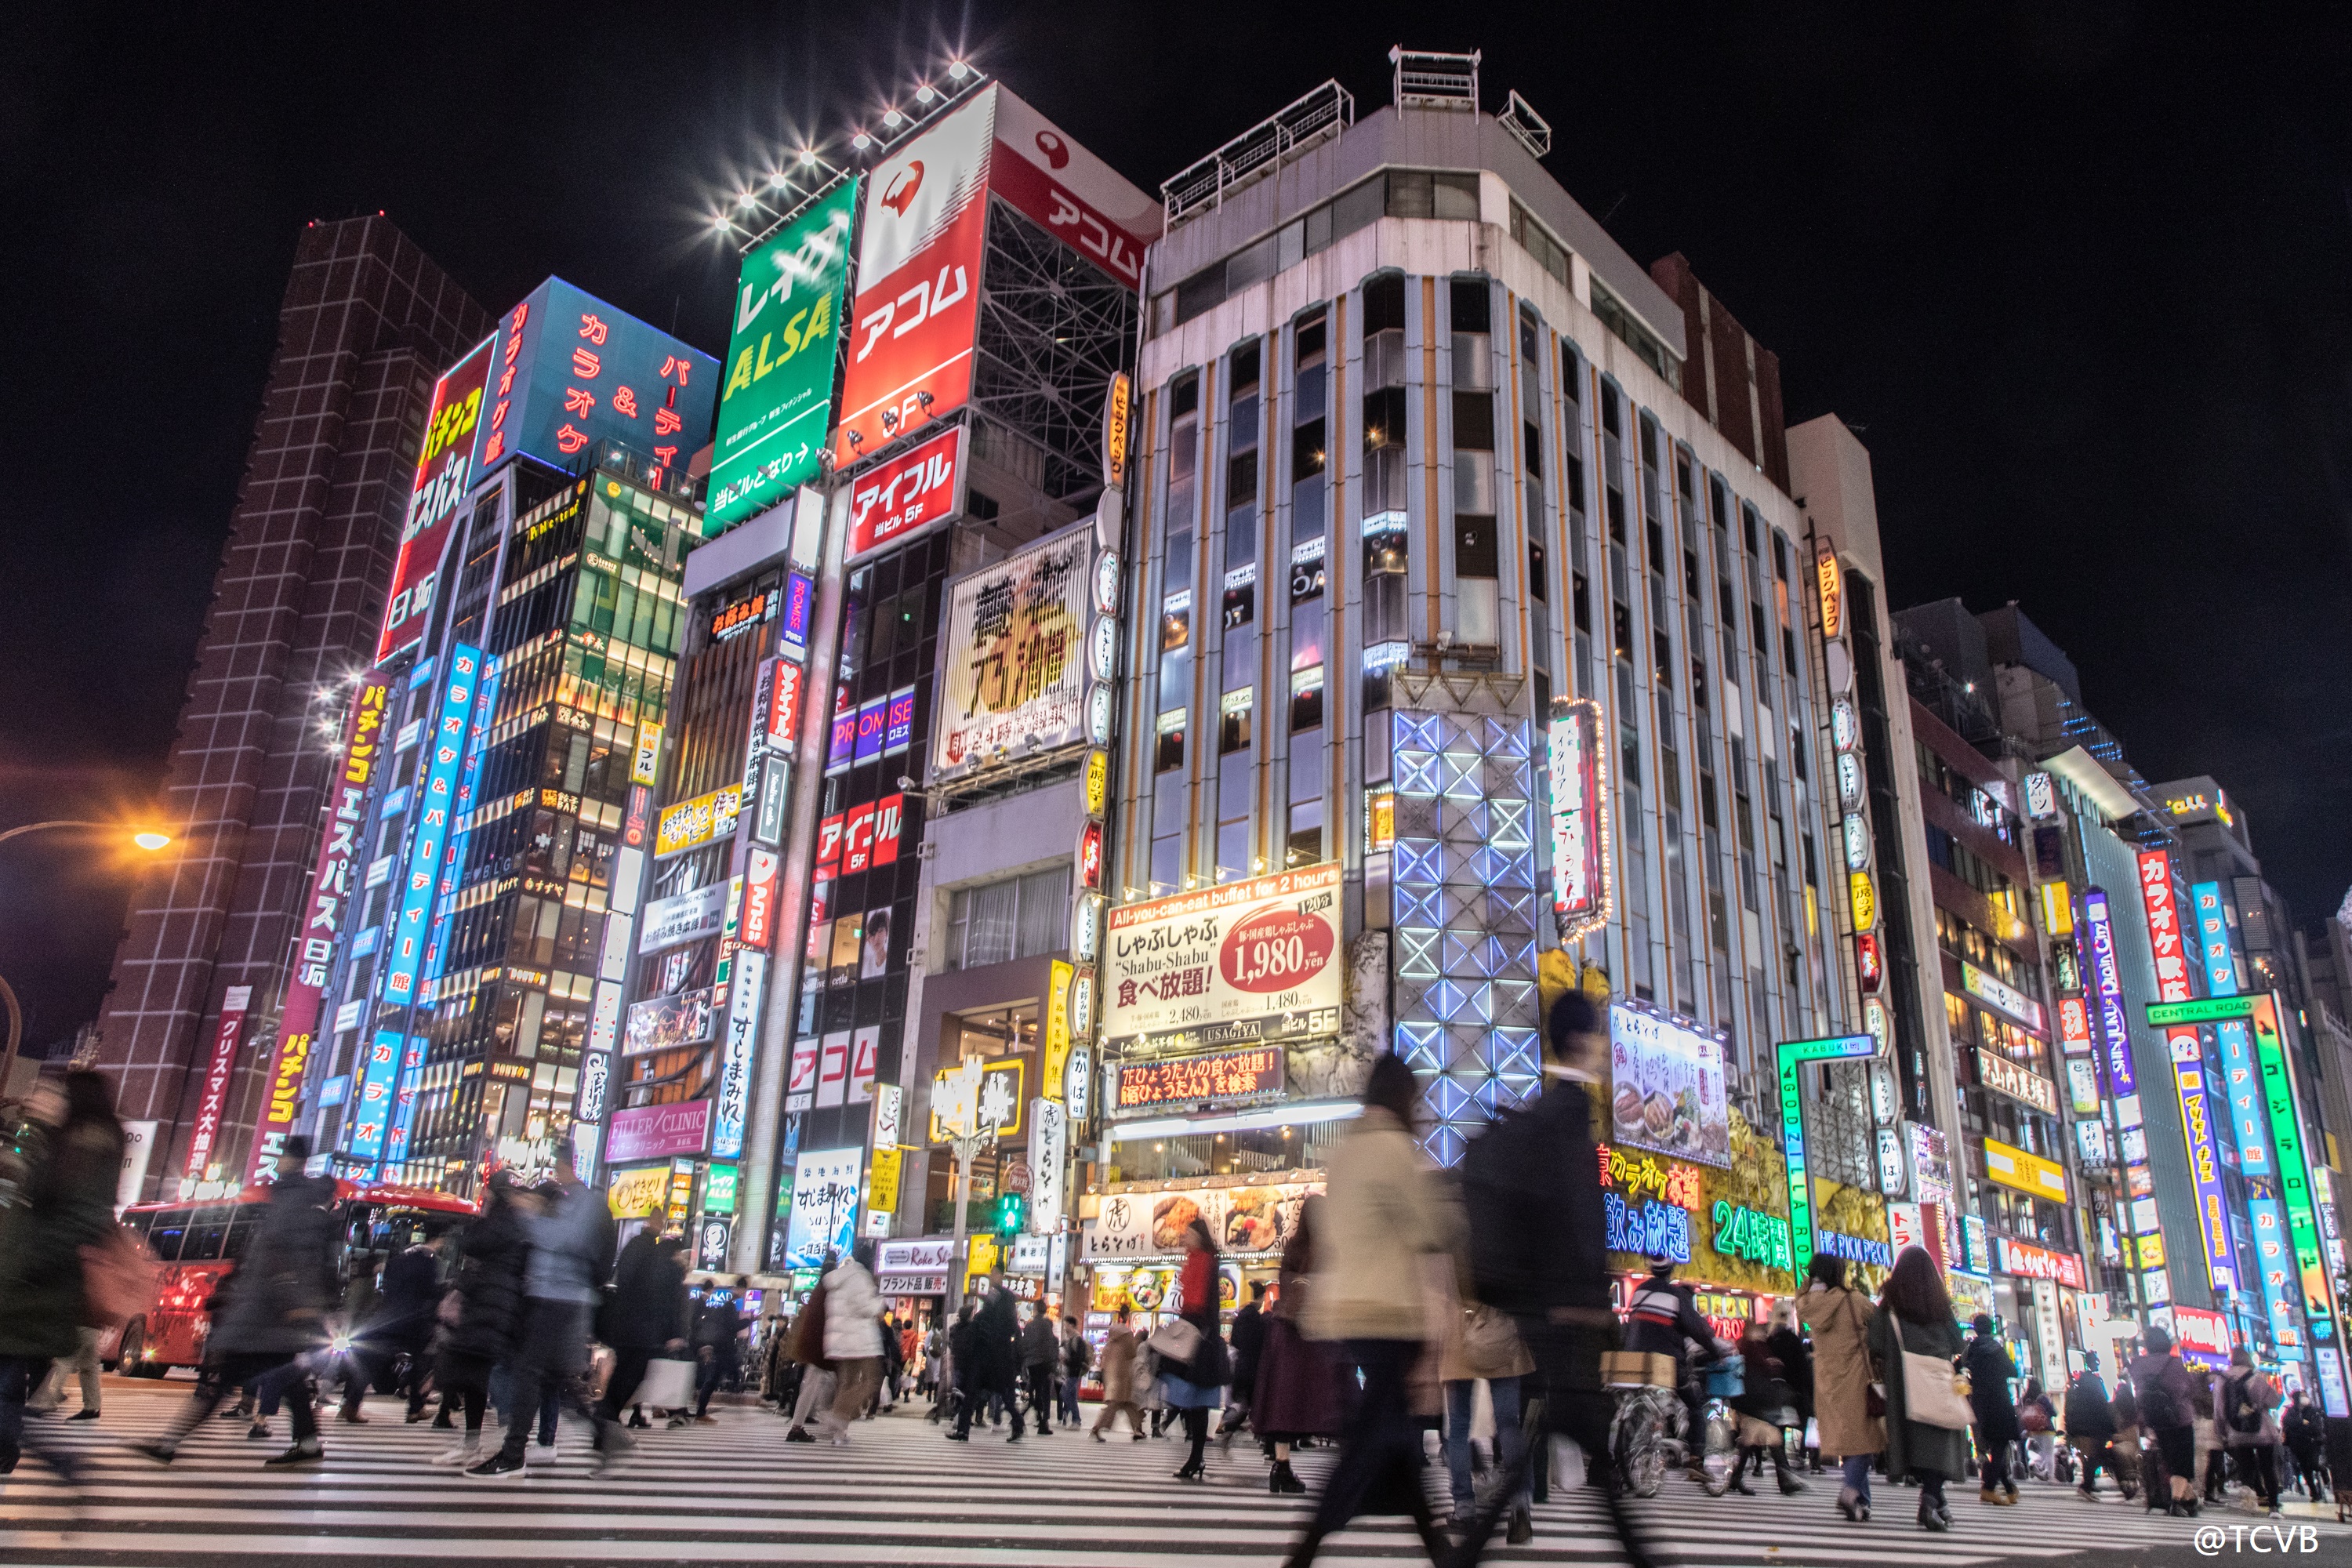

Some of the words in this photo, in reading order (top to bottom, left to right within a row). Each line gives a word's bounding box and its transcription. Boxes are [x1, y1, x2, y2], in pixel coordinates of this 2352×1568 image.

[1048, 188, 1138, 280] アコム
[856, 263, 968, 364] アコム
[723, 291, 833, 402] ALSA
[484, 302, 531, 468] カラオケ館
[556, 314, 608, 455] カラオケ
[612, 385, 638, 419] &
[418, 387, 483, 468] パチンコ
[653, 354, 691, 492] パーティー
[401, 451, 469, 545] エスパス
[855, 452, 953, 528] アイフル
[873, 513, 902, 539] 当ビル
[904, 503, 924, 524] 5F
[790, 579, 806, 630] PROMISE
[345, 684, 386, 784] パチンコ
[834, 699, 913, 746] PROMISE
[1089, 768, 1104, 802] 虎の子
[1556, 735, 1566, 804] イタリアン
[820, 805, 902, 859] アイフル
[850, 853, 866, 870] 5F
[1113, 896, 1209, 927] All-you-can-eat
[1211, 886, 1252, 906] buffet
[1254, 880, 1276, 897] for
[1279, 877, 1290, 893] 2
[1293, 868, 1337, 890] hours
[1300, 894, 1330, 914] 120分
[1855, 886, 1873, 917] 虎の子
[1116, 915, 1219, 959] しゃぶしゃぶ
[1232, 935, 1305, 985] 1,980
[1304, 954, 1324, 969] yen
[2201, 895, 2230, 982] カラオケ
[1116, 964, 1214, 1009] 食べ放題!
[1265, 990, 1299, 1011] 1,480
[1298, 995, 1312, 1008] yen
[2152, 1004, 2212, 1019] CENTRAL
[2215, 1000, 2252, 1013] ROAD
[1168, 1005, 1200, 1025] 2,480
[1199, 1011, 1212, 1022] yen
[1207, 1022, 1259, 1042] USAGIYA
[1308, 1009, 1337, 1034] 5F
[267, 1033, 310, 1123] パチンコ
[720, 1016, 753, 1123] すしまみれ
[790, 1039, 878, 1089] アコム
[1991, 1058, 2046, 1109] 山内農場
[608, 1138, 666, 1156] フィラークリニック
[1784, 1083, 1805, 1210] GODZILLA
[2184, 1093, 2216, 1184] マツモトキヨシ
[710, 1174, 735, 1188] レイク
[2263, 1060, 2318, 1269] ゴジラロード
[631, 1194, 659, 1210] センター
[1106, 1197, 1131, 1232] 虎
[1090, 1233, 1140, 1252] とらそば
[1603, 1192, 1691, 1265] 飲み放題
[1713, 1200, 1791, 1272] 24時間
[909, 1247, 933, 1266] Roko
[2257, 1213, 2297, 1345] カラオケ館
[883, 1278, 923, 1291] ブランド品
[1101, 1293, 1127, 1306] 500
